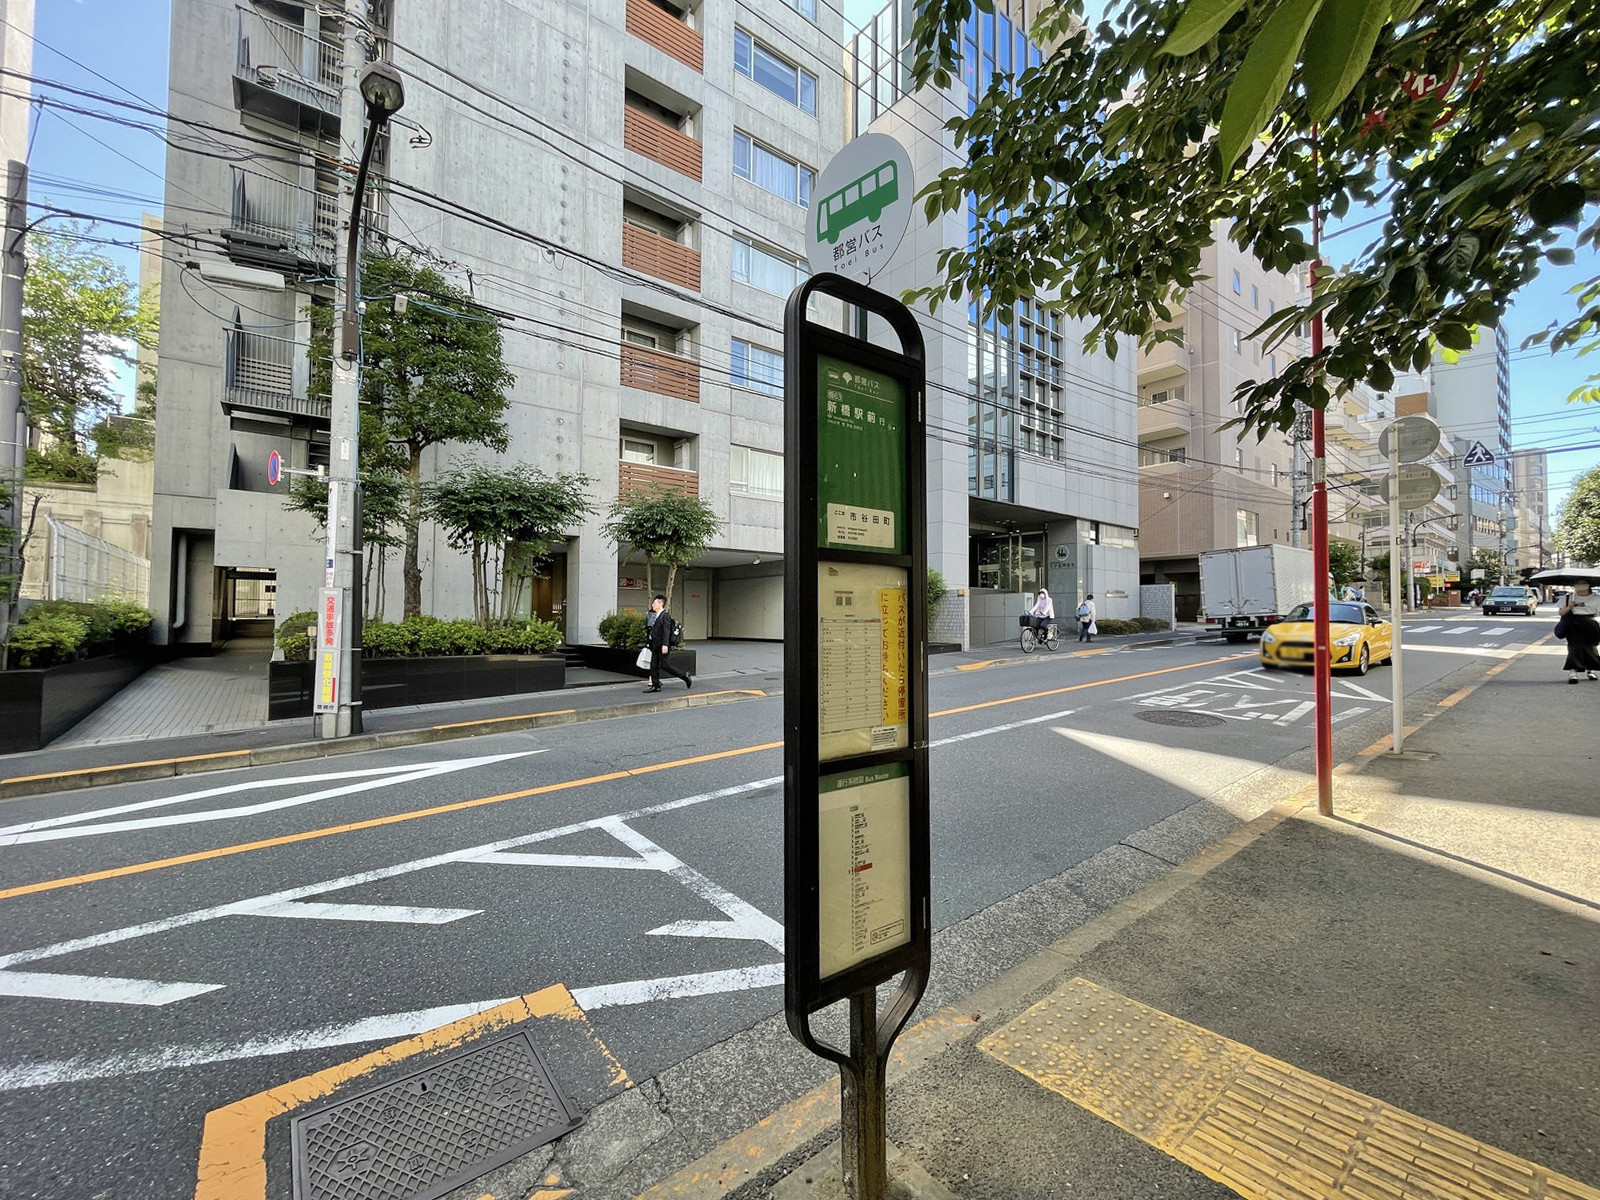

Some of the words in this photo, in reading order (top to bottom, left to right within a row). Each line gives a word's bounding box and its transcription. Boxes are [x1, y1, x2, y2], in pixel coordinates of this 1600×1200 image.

[833, 225, 882, 261] 都営バス
[834, 255, 857, 272] Toei
[864, 243, 884, 257] Bus
[325, 596, 335, 646] 交通事故多発
